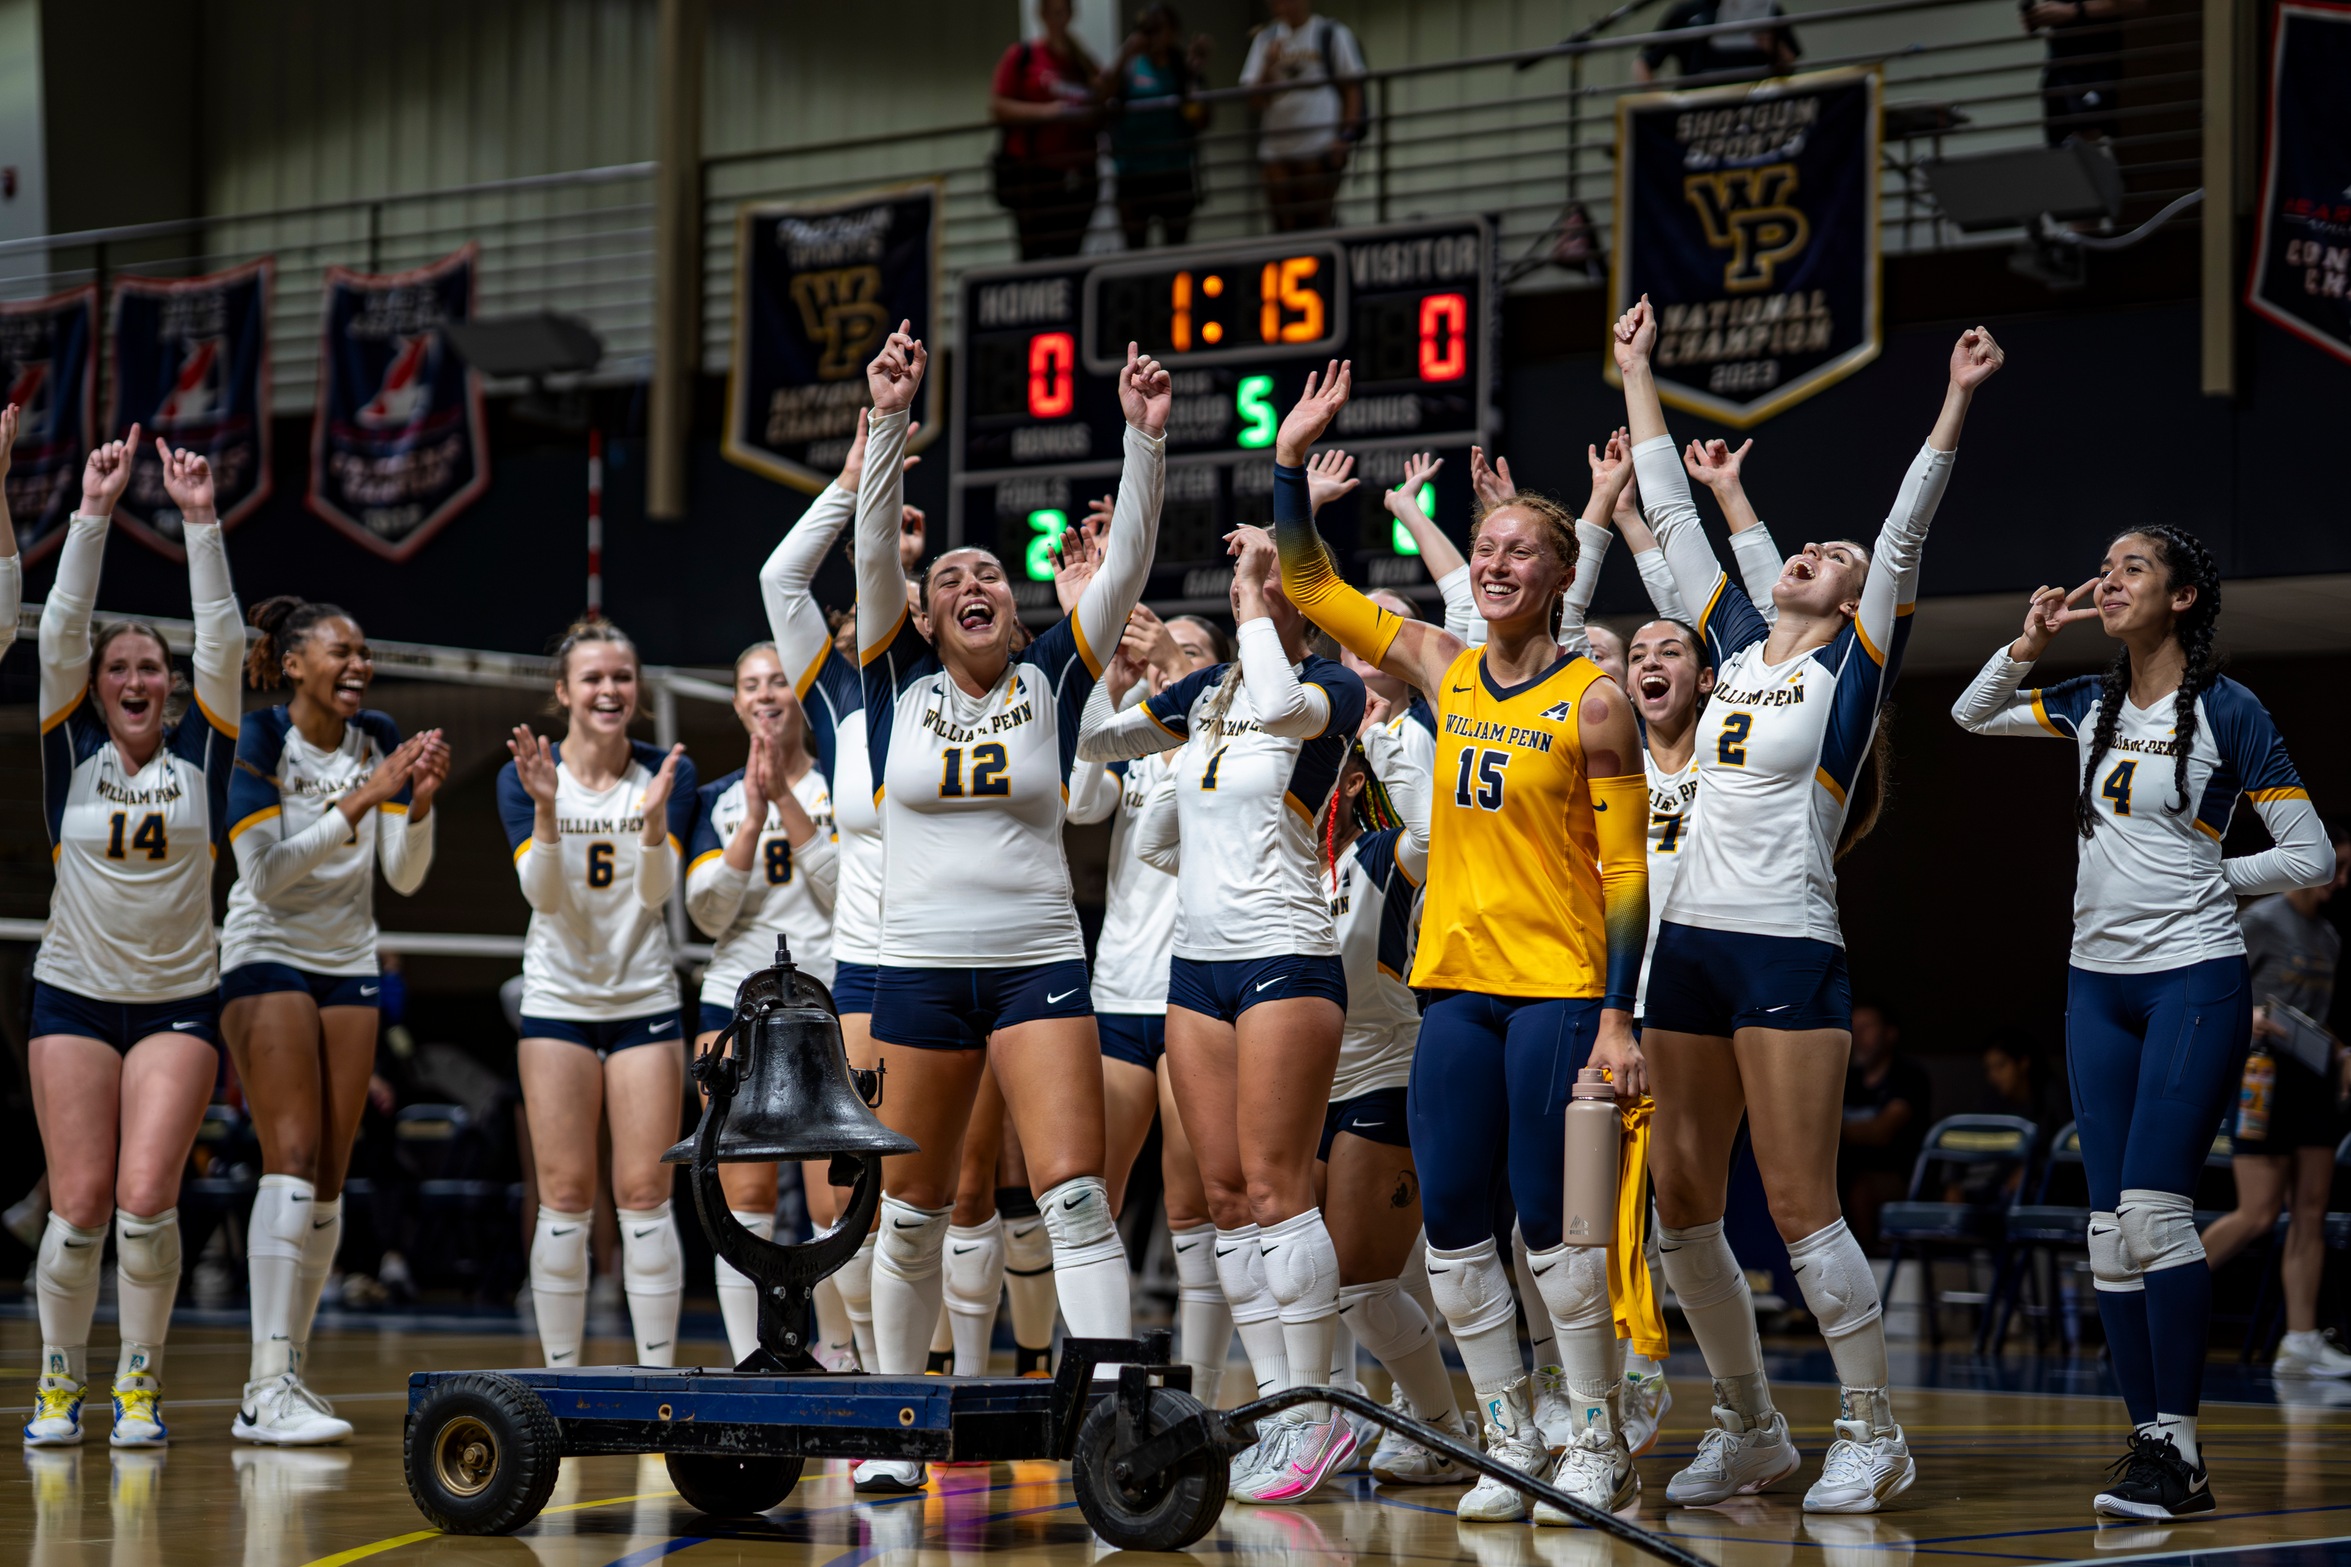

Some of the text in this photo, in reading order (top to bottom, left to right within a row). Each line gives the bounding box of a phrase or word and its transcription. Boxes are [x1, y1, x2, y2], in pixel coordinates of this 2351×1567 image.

[1350, 233, 1479, 292] VISITOR
[976, 277, 1077, 329] HOME
[1659, 289, 1832, 334] NATIONAL
[1418, 291, 1469, 383] 0
[1656, 317, 1835, 368] CHAMPION
[1027, 330, 1076, 420] 0
[1708, 356, 1781, 394] 2023
[1236, 374, 1278, 449] 5
[1336, 391, 1423, 437] BONUS
[1009, 419, 1093, 463] BONUS
[1025, 508, 1069, 582] 2
[990, 700, 1033, 734] PENN
[1712, 681, 1763, 705] ILLIAM
[1445, 714, 1554, 752] WILLIAM PENN
[1716, 711, 1754, 768] 2
[97, 777, 150, 806] WILLIAM
[939, 741, 1011, 799] 12
[1454, 746, 1512, 813] 15
[2101, 759, 2139, 816] 4
[105, 811, 168, 861] 14
[559, 817, 645, 834] ILLIAM PEN
[1652, 811, 1685, 854] 7
[587, 841, 616, 890] 6
[763, 836, 794, 887] 8
